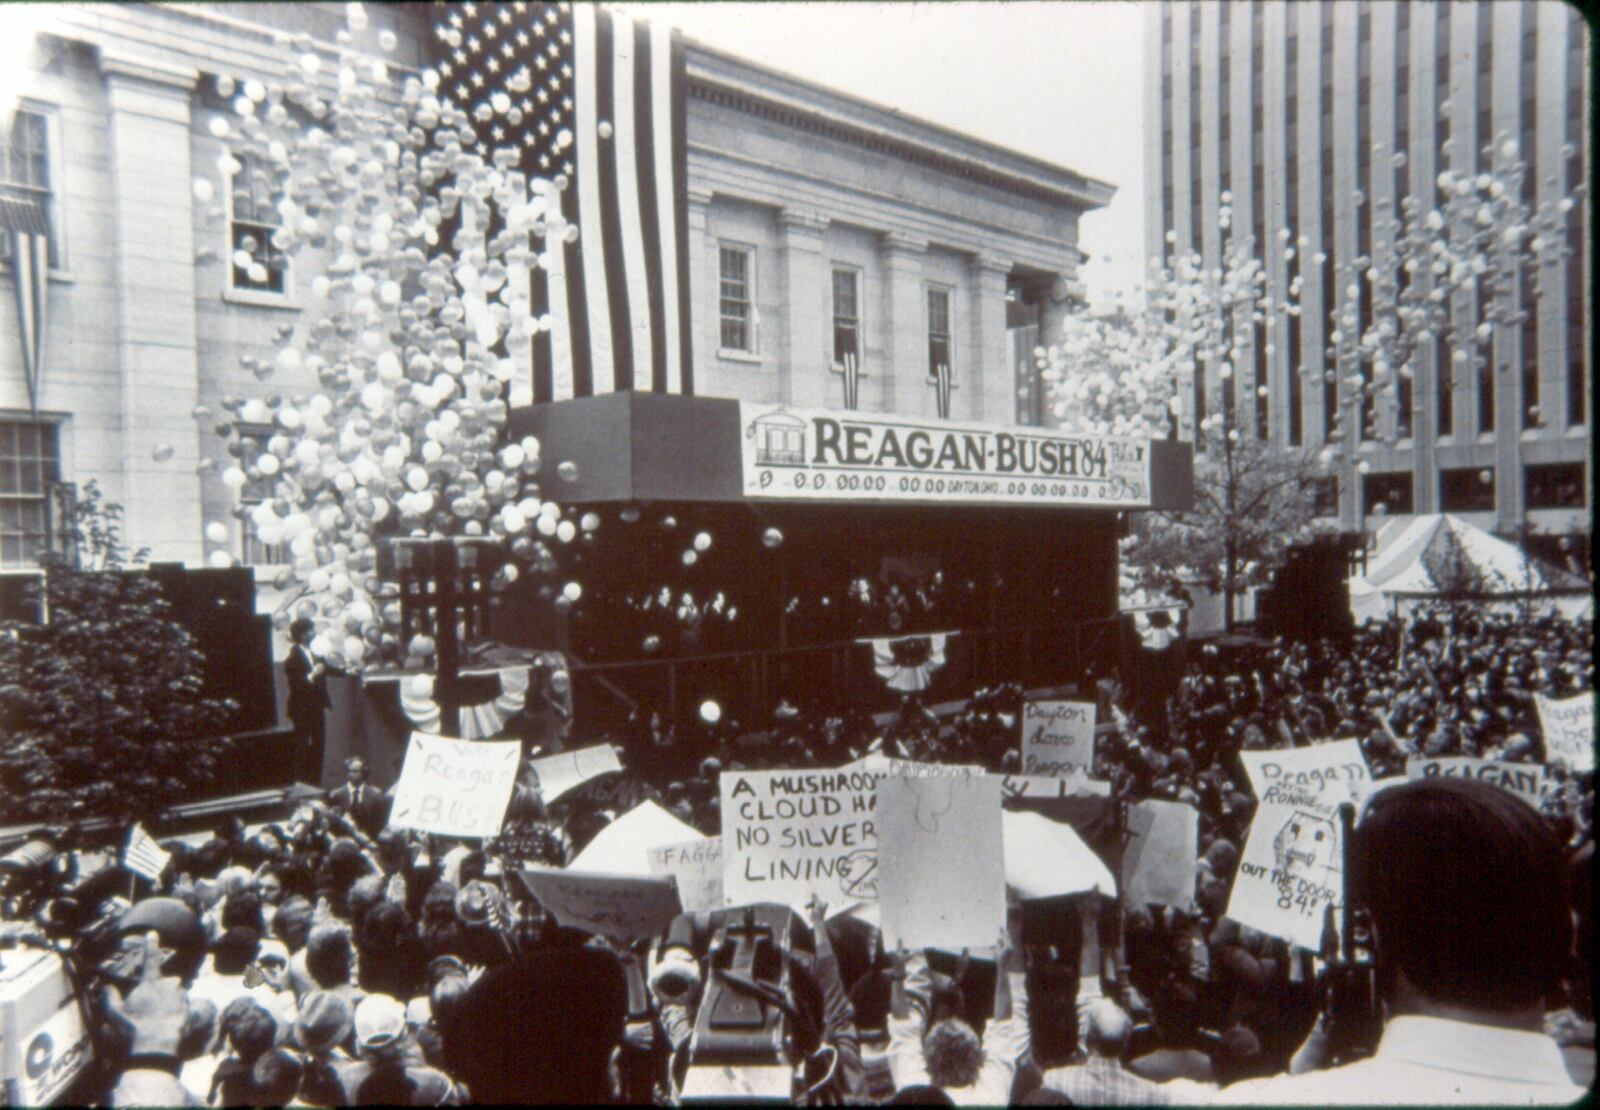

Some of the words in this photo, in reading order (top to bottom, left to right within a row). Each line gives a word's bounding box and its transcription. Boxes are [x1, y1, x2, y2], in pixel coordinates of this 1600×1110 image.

[811, 417, 1078, 476] REAGAN-BUSH
[1078, 438, 1107, 478] '84
[422, 752, 512, 793] Reagan
[731, 778, 756, 798] A
[740, 795, 841, 820] CLOUD
[736, 826, 770, 851] NO
[780, 820, 879, 848] SILVER
[745, 855, 852, 882] LINING
[1241, 862, 1268, 879] OUT
[1271, 868, 1298, 887] THE
[1297, 879, 1336, 903] DOOR
